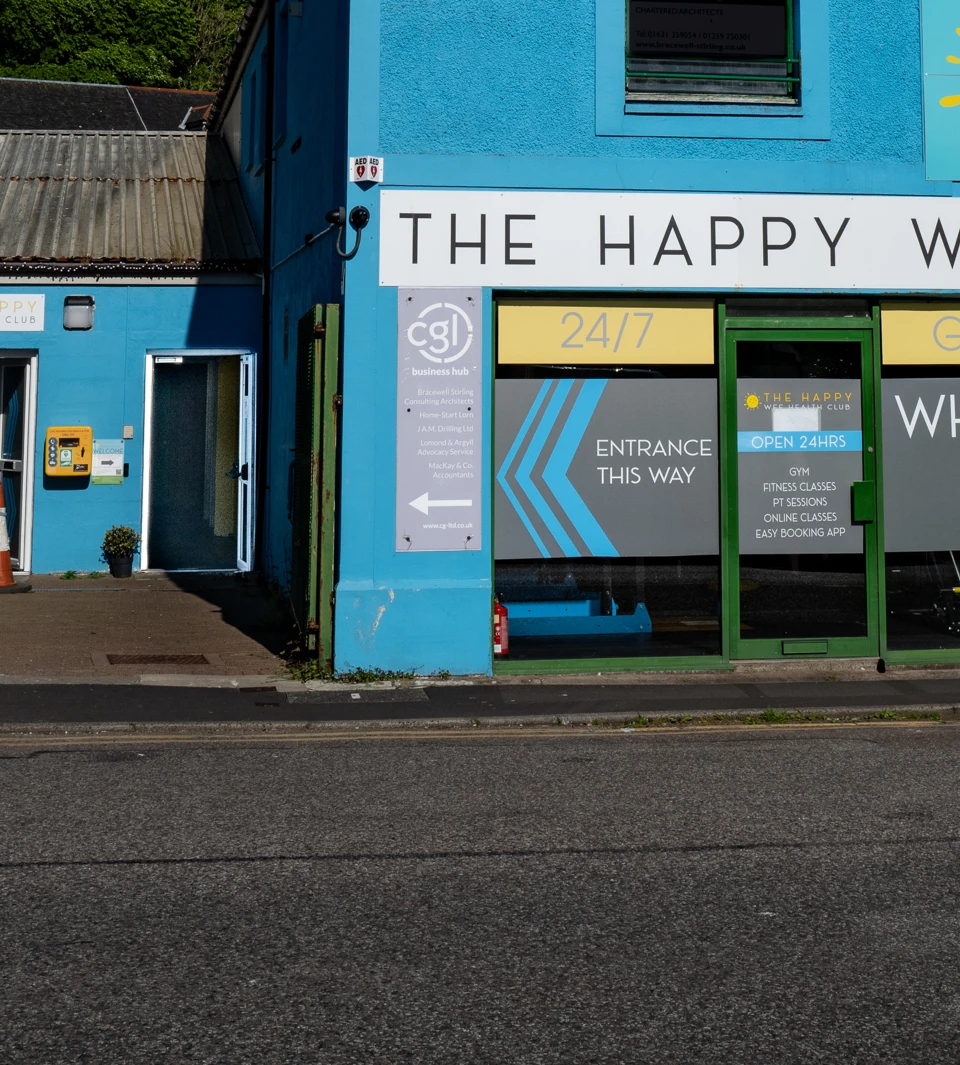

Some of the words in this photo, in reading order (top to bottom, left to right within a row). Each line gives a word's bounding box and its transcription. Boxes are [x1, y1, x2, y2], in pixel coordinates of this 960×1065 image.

[635, 7, 678, 15] CHARTERED
[679, 8, 724, 16] ARCHITECTS
[399, 213, 535, 265] THE
[600, 215, 850, 266] HAPPY
[5, 315, 36, 324] CLUB
[407, 314, 458, 353] cgl
[561, 312, 653, 352] 24/7
[411, 366, 450, 377] business
[451, 366, 470, 377] hub
[417, 387, 450, 396] Bracewell
[450, 387, 474, 397] Stirling
[763, 392, 792, 402] THE
[801, 392, 854, 402] HAPPY
[404, 397, 440, 406] Consulting
[440, 397, 474, 405] Architects
[826, 403, 851, 411] CLUB
[419, 411, 458, 419] Home-Start
[458, 411, 474, 419] Lorn
[437, 424, 462, 434] Drilling
[462, 424, 474, 433] Ltd
[420, 438, 447, 447] Lomond
[447, 439, 454, 447] &
[454, 438, 474, 448] Argyll
[749, 434, 795, 450] OPEN
[798, 433, 847, 450] 24HRS
[417, 448, 450, 457] Advocacy
[450, 448, 474, 456] Service
[595, 438, 713, 457] ENTRANCE
[428, 462, 456, 471] MacKay
[456, 462, 462, 470] &
[432, 470, 474, 479] Accountants
[595, 466, 642, 485] THIS
[648, 466, 696, 485] WAY
[788, 467, 810, 477] GYM
[763, 482, 798, 492] FITNESS
[799, 481, 837, 492] CLASSES
[772, 498, 785, 507] PT
[786, 497, 828, 507] SESSIONS
[763, 513, 798, 523] ONLINE
[800, 512, 838, 522] CLASSES
[755, 528, 778, 539] EASY
[780, 527, 825, 538] BOOKING
[827, 527, 846, 537] APP
